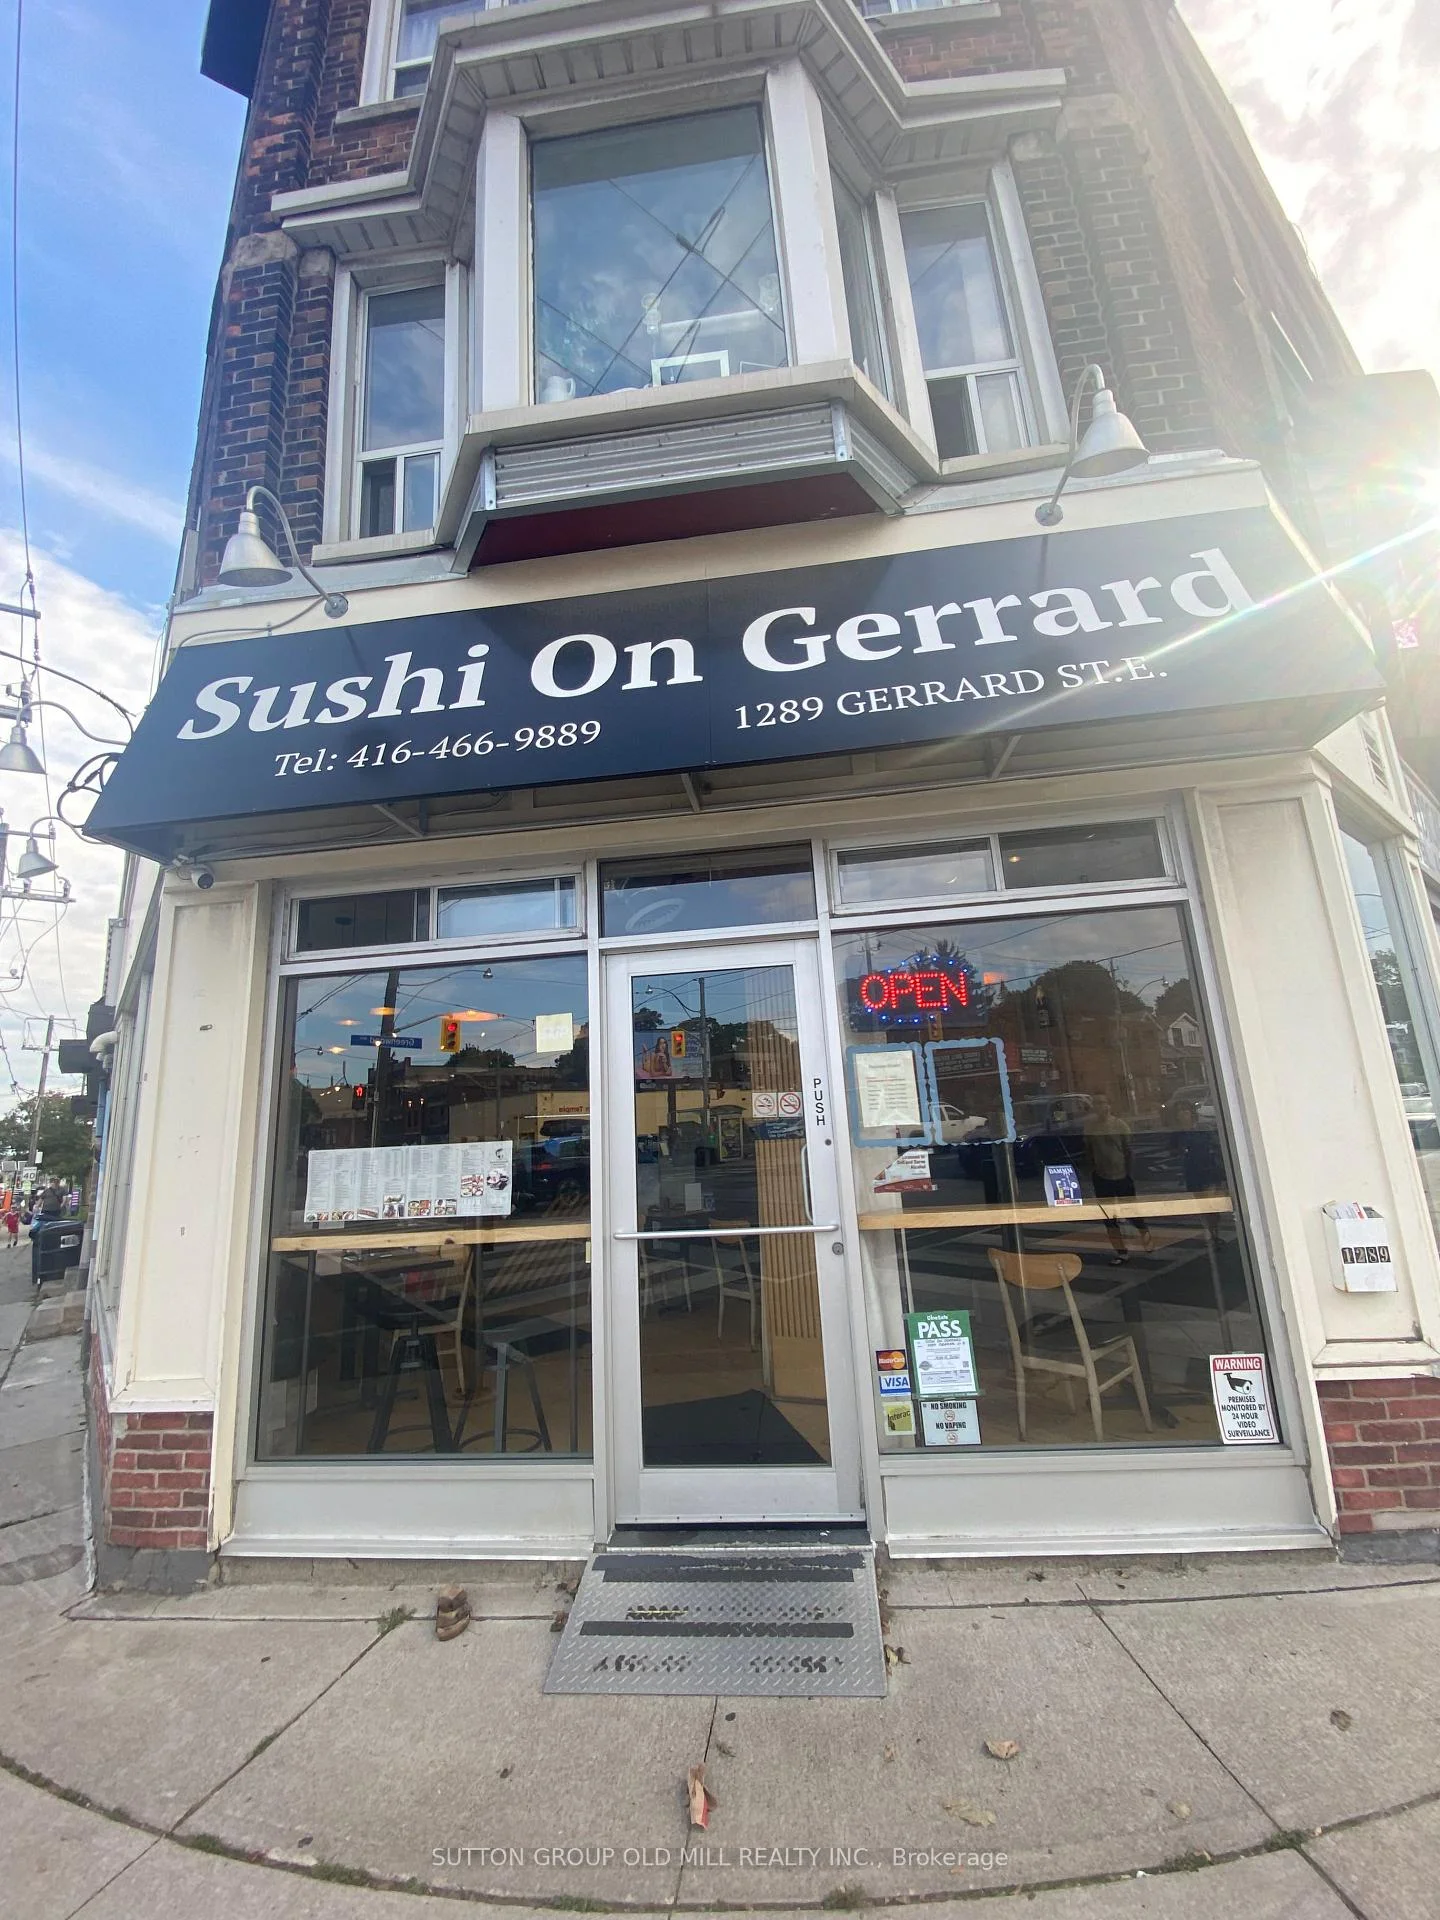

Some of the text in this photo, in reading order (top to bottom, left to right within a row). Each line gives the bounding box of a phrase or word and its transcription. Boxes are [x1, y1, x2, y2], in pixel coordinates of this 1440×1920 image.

[177, 548, 1260, 740] Sushi On Gerrard
[735, 697, 824, 730] 1289
[836, 669, 1046, 717] GERRARD
[274, 720, 602, 777] Tel: 416-466-9889
[860, 971, 968, 1009] OPEN
[813, 1078, 825, 1125] PUSH
[23, 1172, 35, 1180] 40
[1341, 1246, 1391, 1264] 1289
[917, 1320, 962, 1338] PASS
[1215, 1358, 1260, 1370] WARNING
[884, 1376, 909, 1387] VISA
[1228, 1395, 1256, 1403] PREMISES
[1221, 1403, 1266, 1411] MONITORED BY
[887, 1410, 911, 1421] Interac
[1231, 1411, 1259, 1420] 24 HOUR
[935, 1421, 967, 1430] NO VAPING
[1237, 1420, 1257, 1428] VIDEO
[1227, 1428, 1271, 1437] SURVEILLANCE
